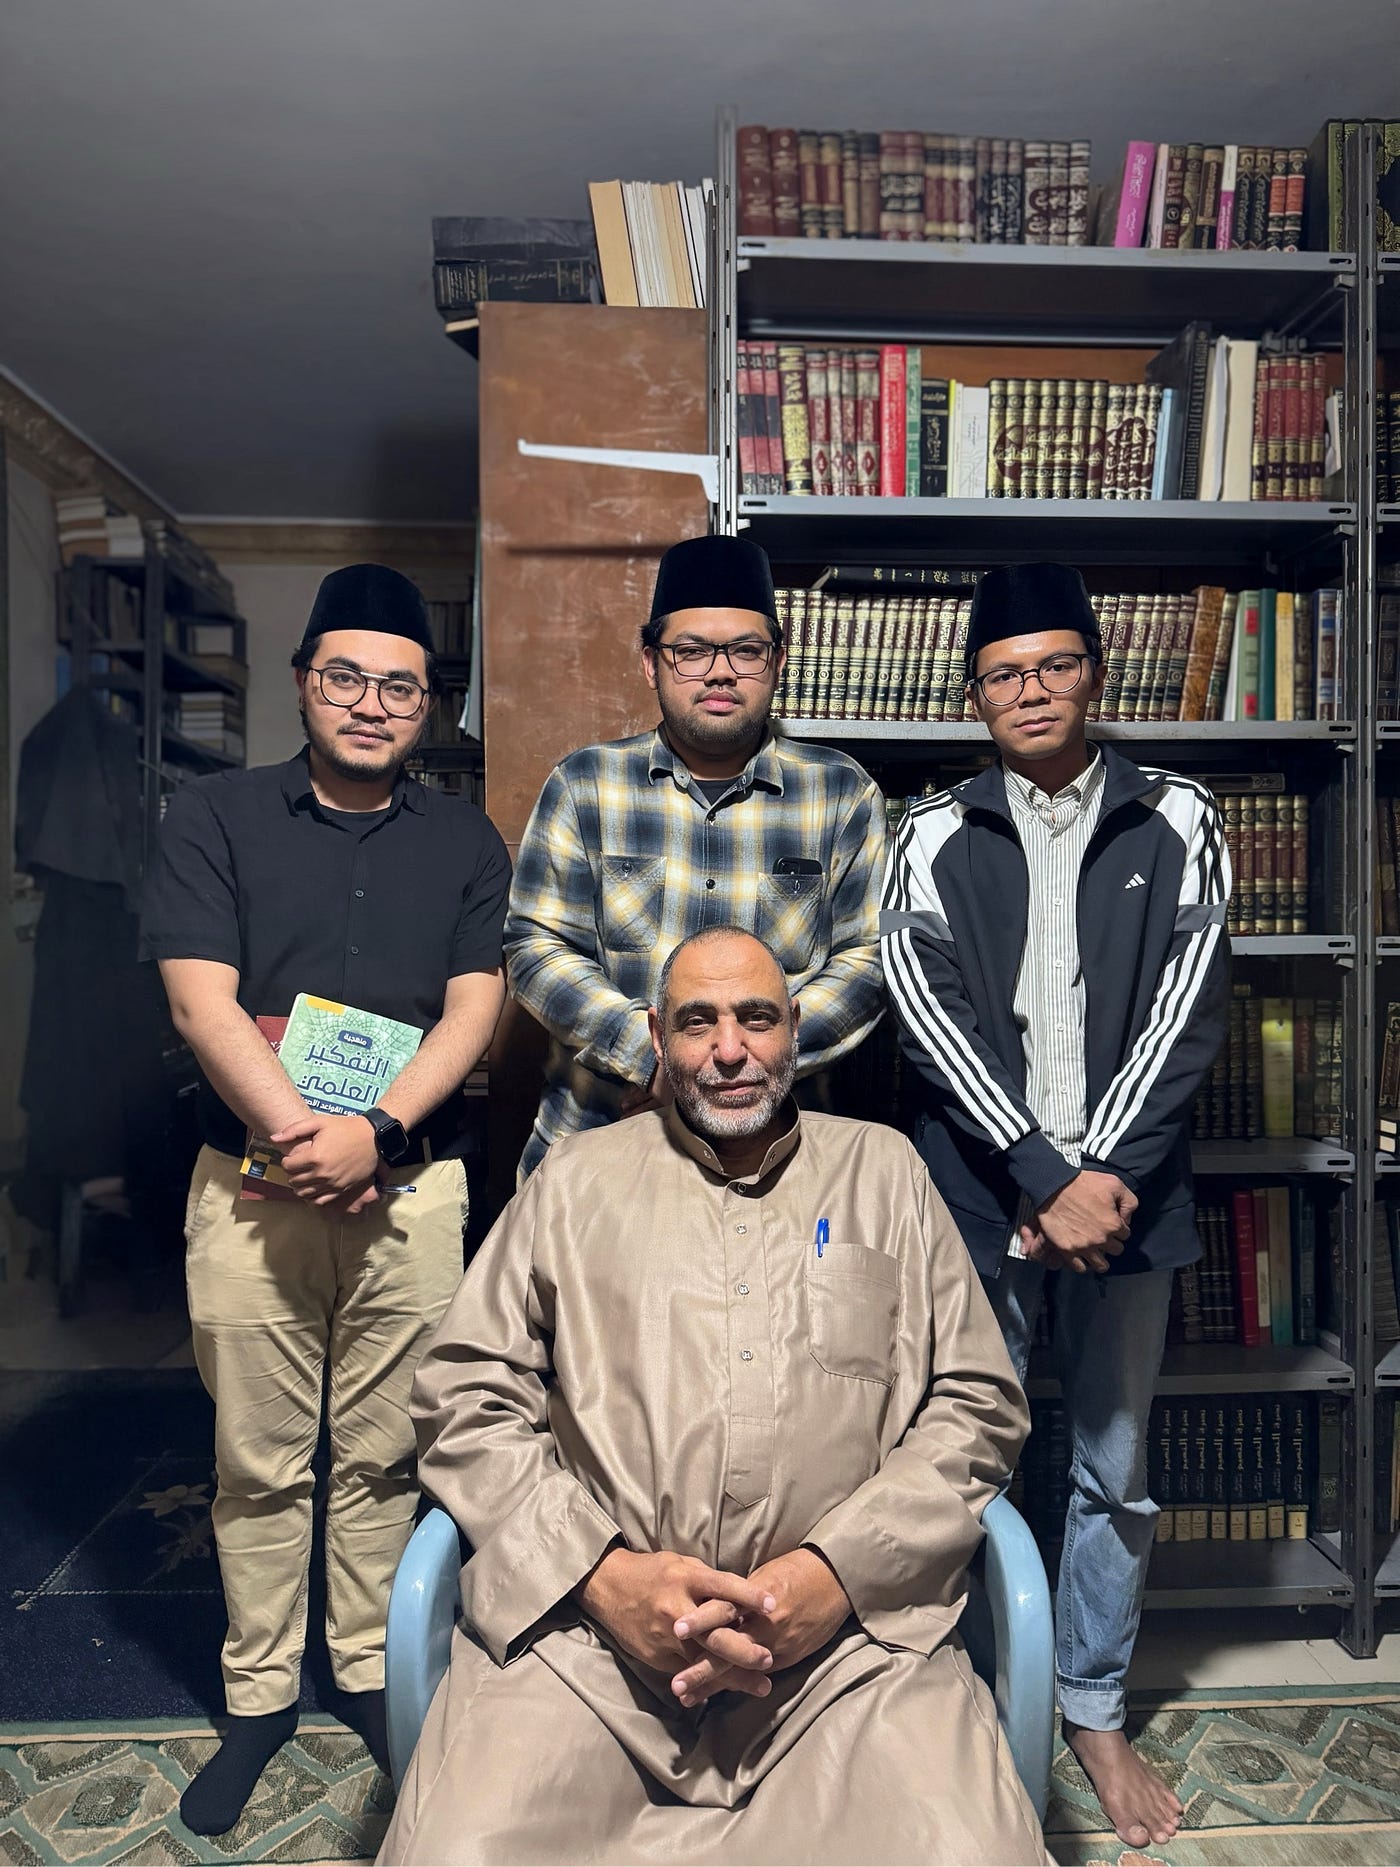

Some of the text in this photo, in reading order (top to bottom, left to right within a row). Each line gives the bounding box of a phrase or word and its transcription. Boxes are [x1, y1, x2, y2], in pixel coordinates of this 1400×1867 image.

[343, 1033, 367, 1046] منهجية
[304, 1044, 389, 1078] التفكير
[296, 1075, 379, 1106] العلمي
[320, 1103, 344, 1114] القواعد
